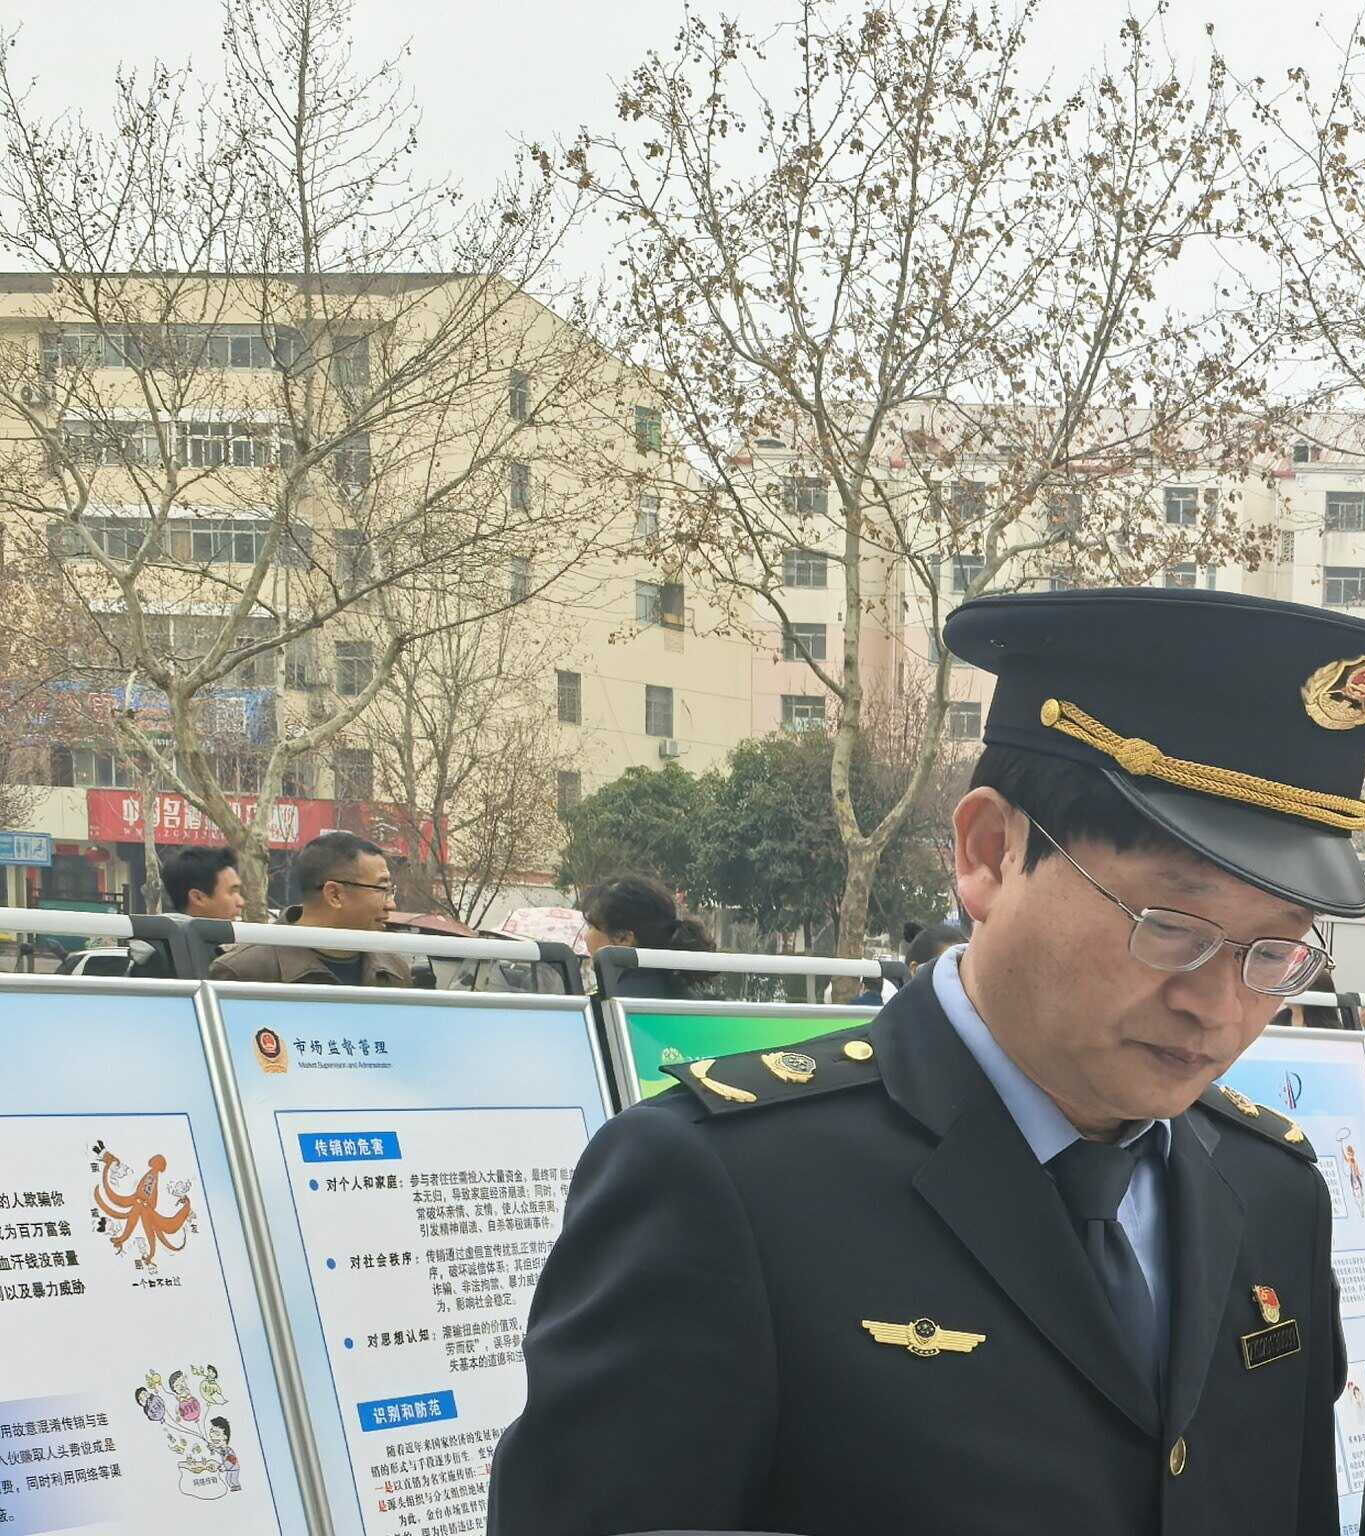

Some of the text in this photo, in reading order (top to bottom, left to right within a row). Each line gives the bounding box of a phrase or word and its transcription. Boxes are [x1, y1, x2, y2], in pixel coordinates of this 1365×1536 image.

[293, 1037, 389, 1057] 市场监督管理
[315, 1138, 385, 1156] 传销的危害
[373, 1399, 443, 1424] 识别和防范
[0, 1463, 122, 1495] 费,同时利用网络等渠
